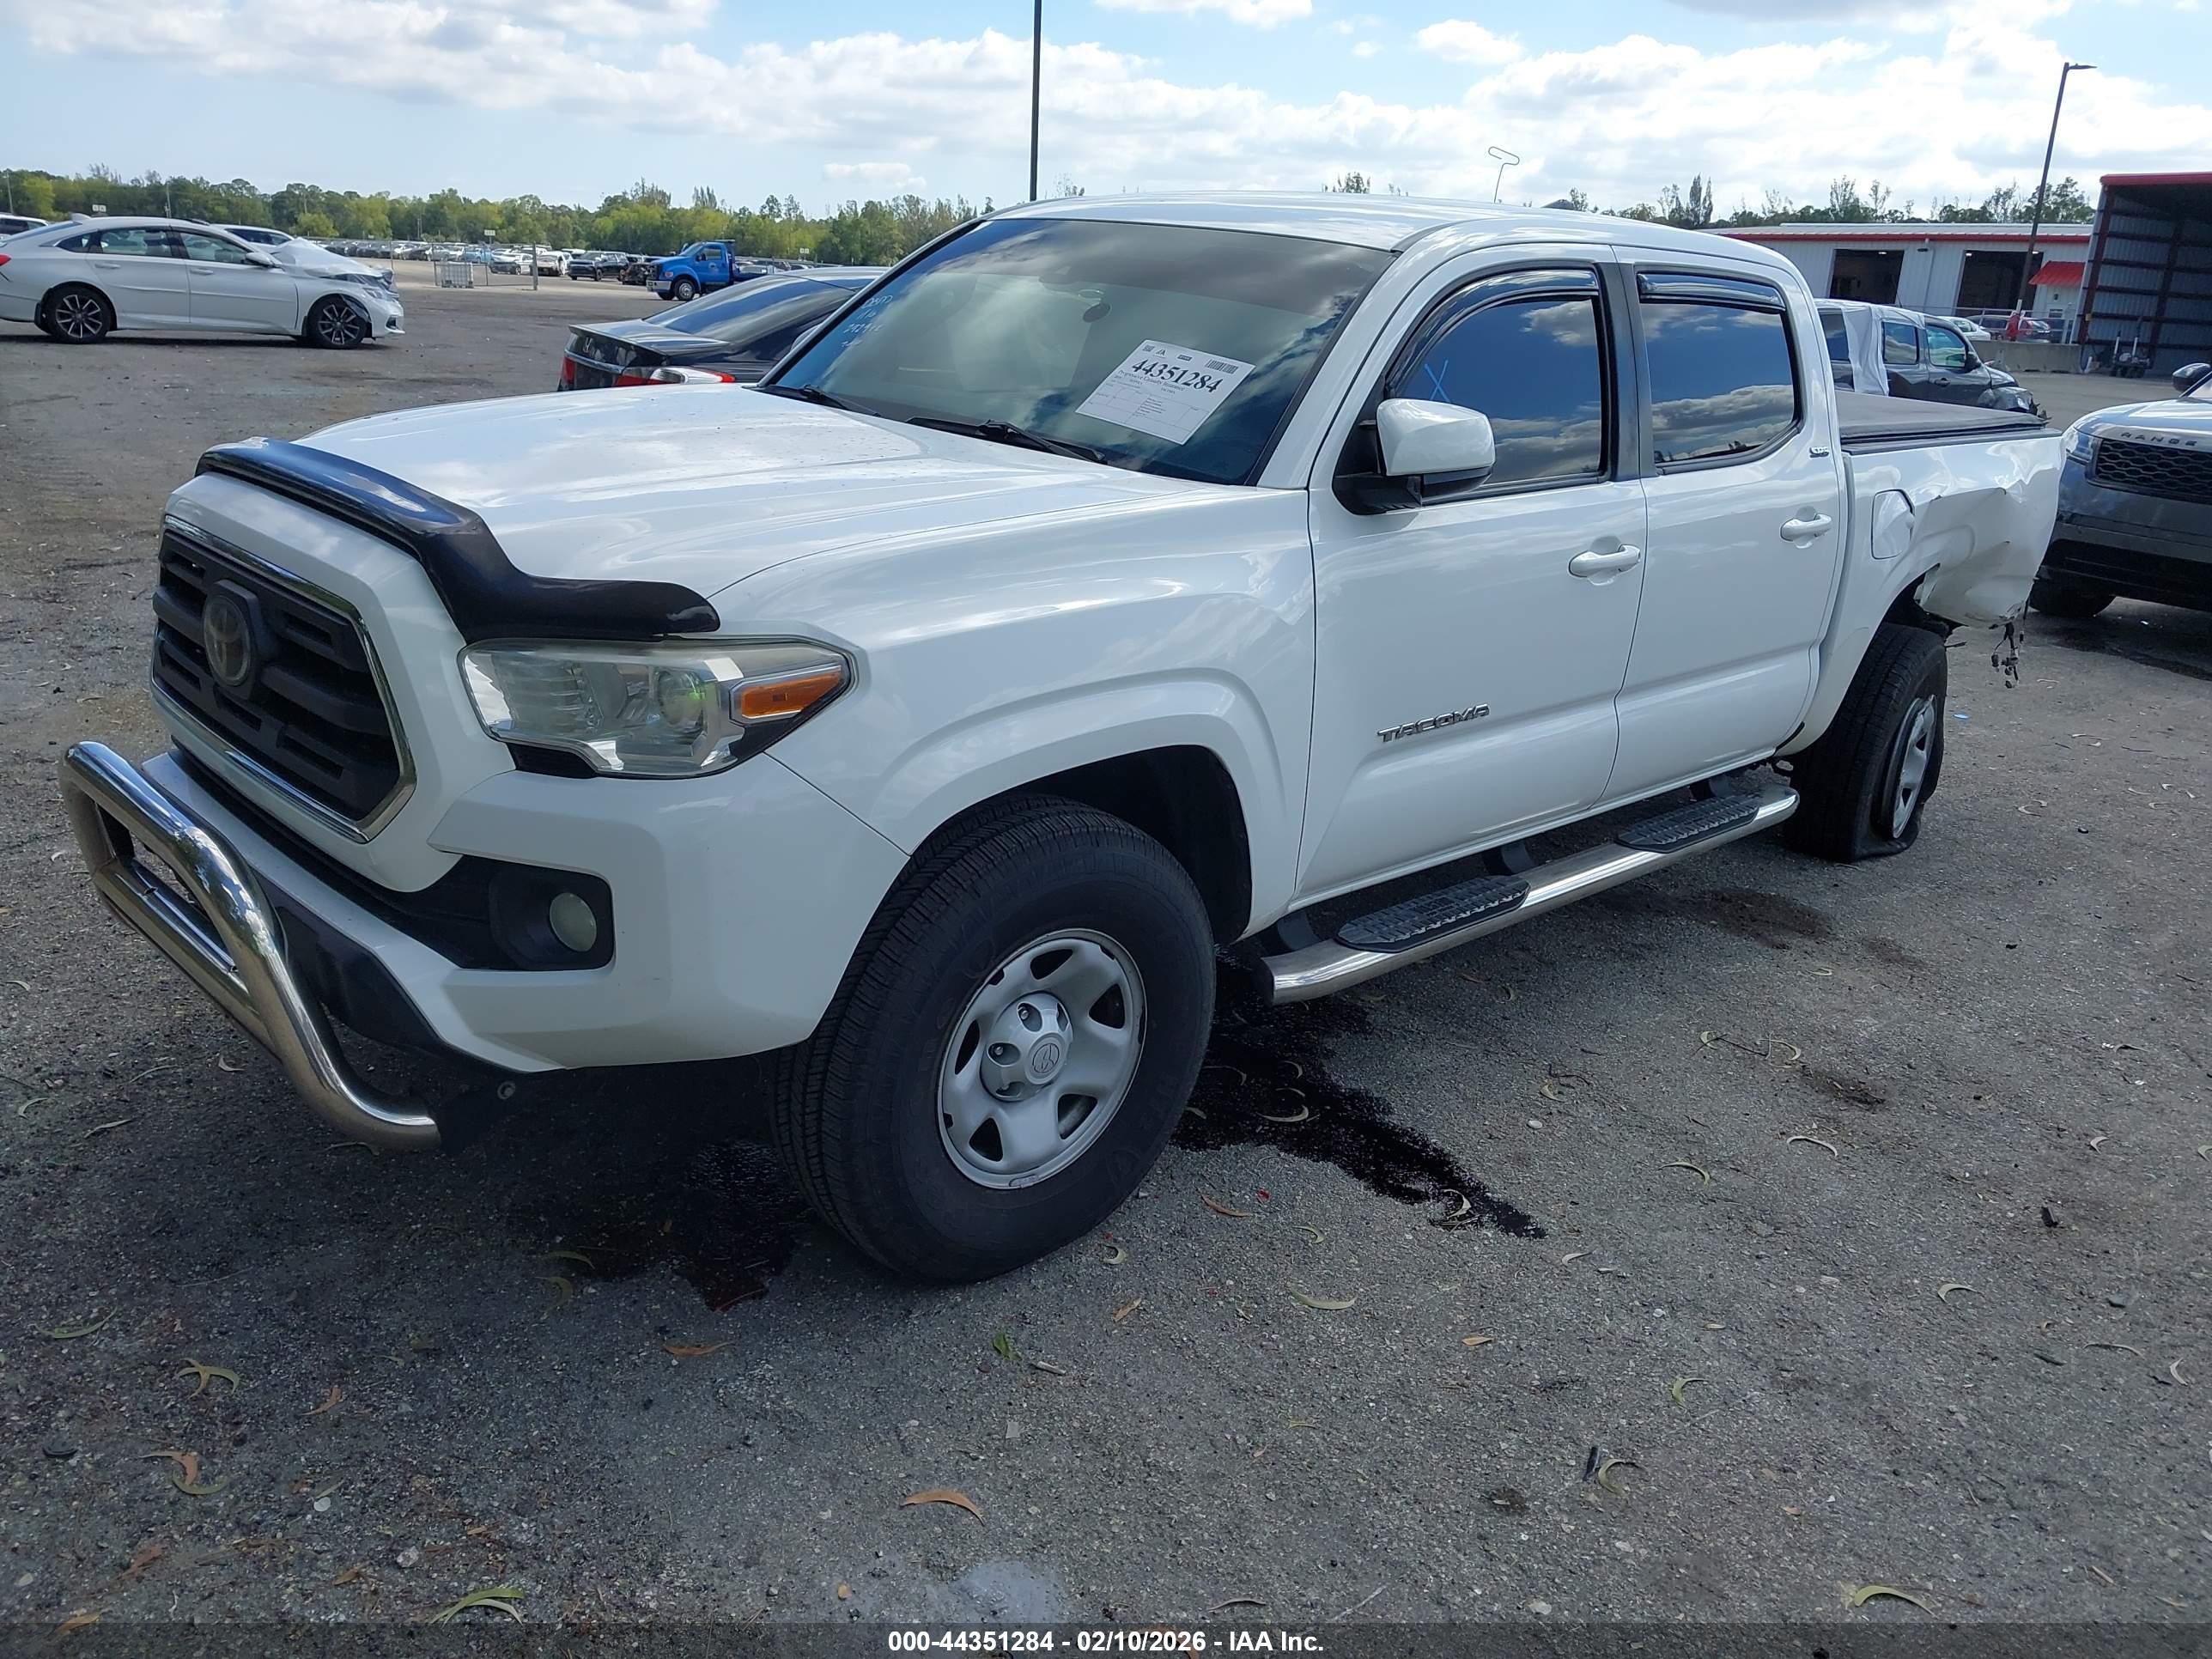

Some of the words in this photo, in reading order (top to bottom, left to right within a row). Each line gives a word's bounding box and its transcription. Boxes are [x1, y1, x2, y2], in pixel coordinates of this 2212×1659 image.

[1132, 359, 1224, 393] 44351284
[2120, 432, 2198, 447] RANGE
[1376, 703, 1491, 743] TACOMA
